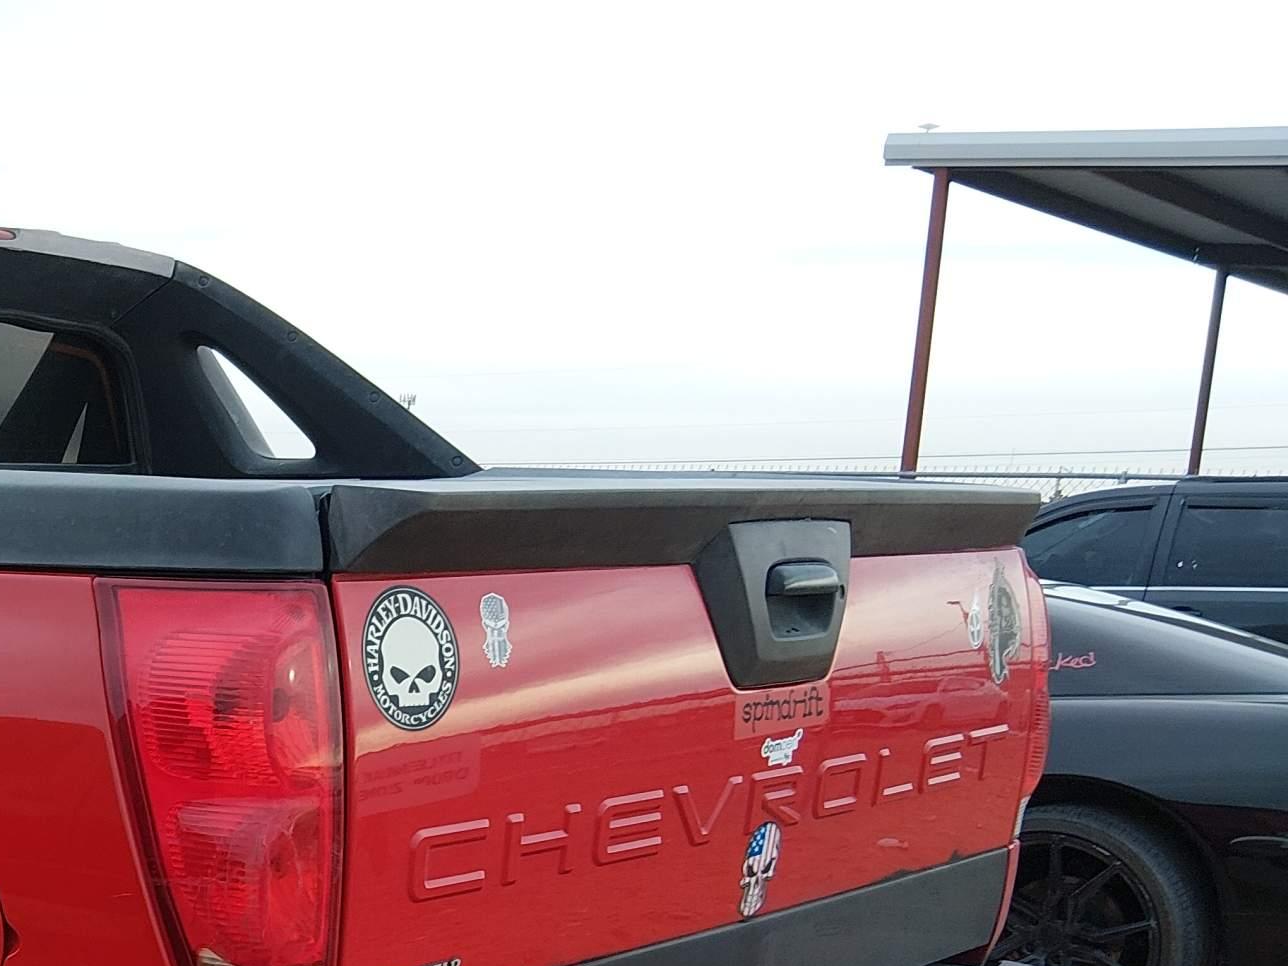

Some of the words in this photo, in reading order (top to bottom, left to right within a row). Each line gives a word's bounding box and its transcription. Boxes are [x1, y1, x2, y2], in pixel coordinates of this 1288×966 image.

[366, 592, 455, 674] HARLEY-DAVIDSON
[373, 680, 452, 725] MOTORCYCLES
[742, 686, 824, 733] spindrift
[410, 724, 1010, 900] CHEVROLET
